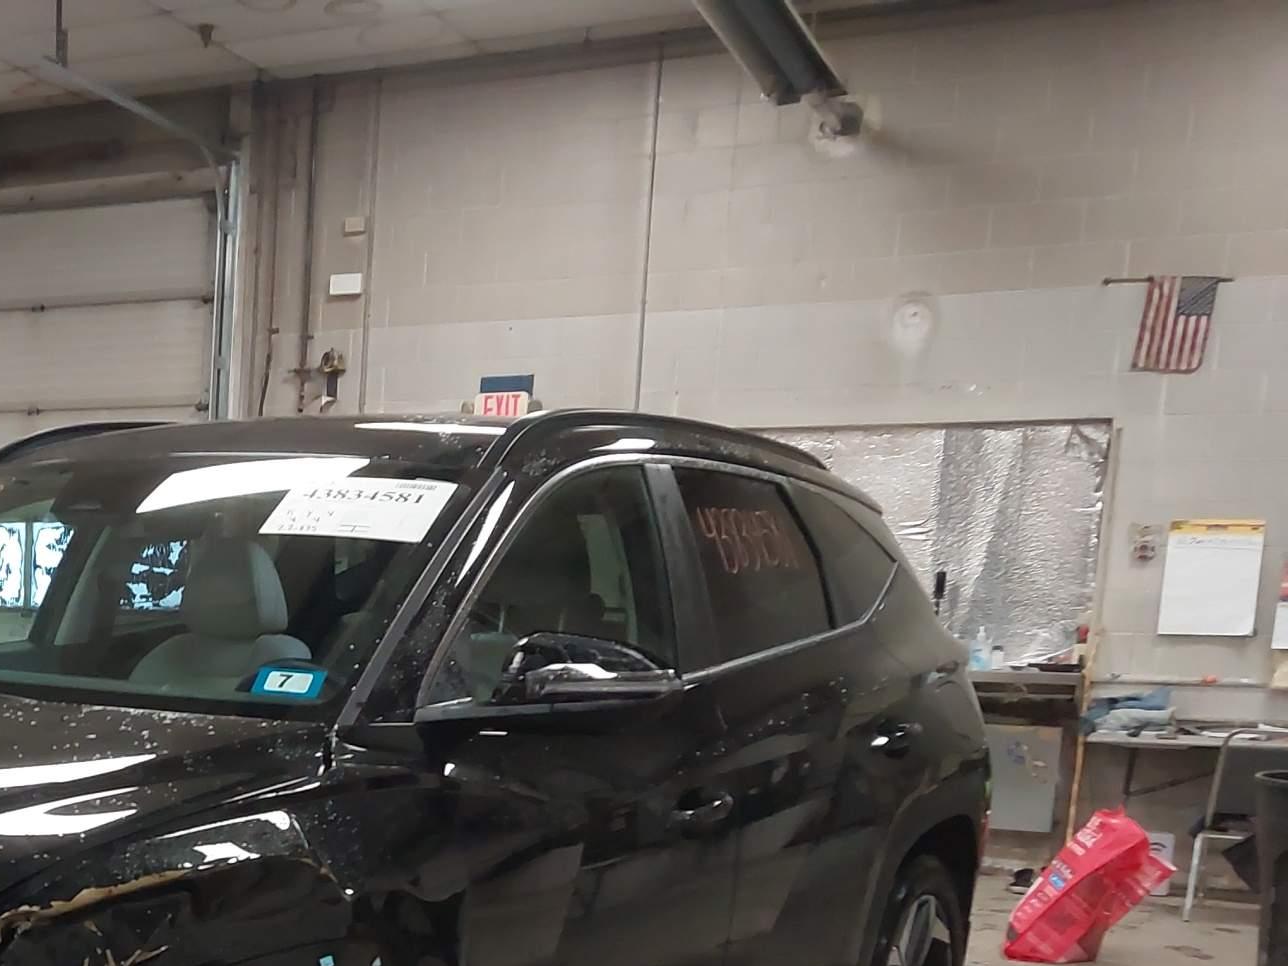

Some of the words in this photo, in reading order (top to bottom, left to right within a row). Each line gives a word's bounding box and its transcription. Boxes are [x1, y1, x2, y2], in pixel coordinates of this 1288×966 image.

[483, 393, 521, 417] EXIT
[303, 488, 425, 505] 43834581
[278, 673, 295, 688] 7
